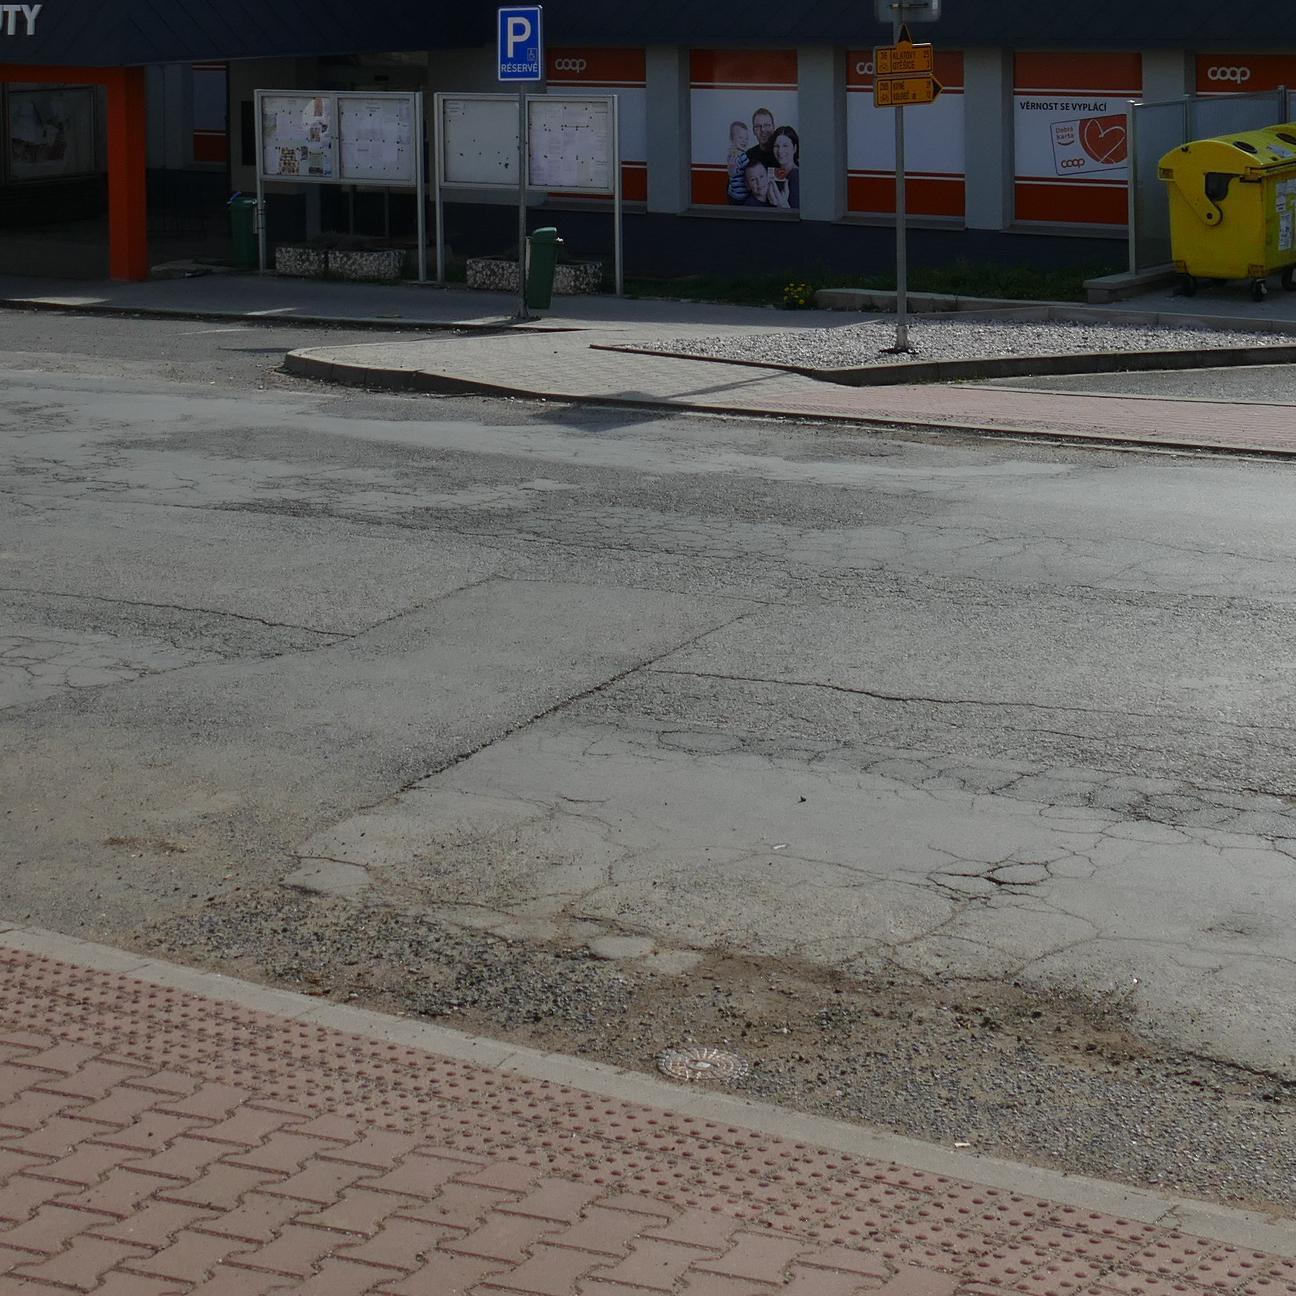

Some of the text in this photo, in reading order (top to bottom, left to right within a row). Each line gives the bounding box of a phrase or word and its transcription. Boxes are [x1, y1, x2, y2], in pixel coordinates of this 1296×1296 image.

[507, 16, 532, 58] P
[501, 61, 539, 73] RÉSERVÉ
[554, 58, 587, 74] coop
[1207, 66, 1251, 85] coop
[1020, 101, 1107, 113] VĚRNOST SE VYPLÁCÍ
[1061, 158, 1085, 169] coop
